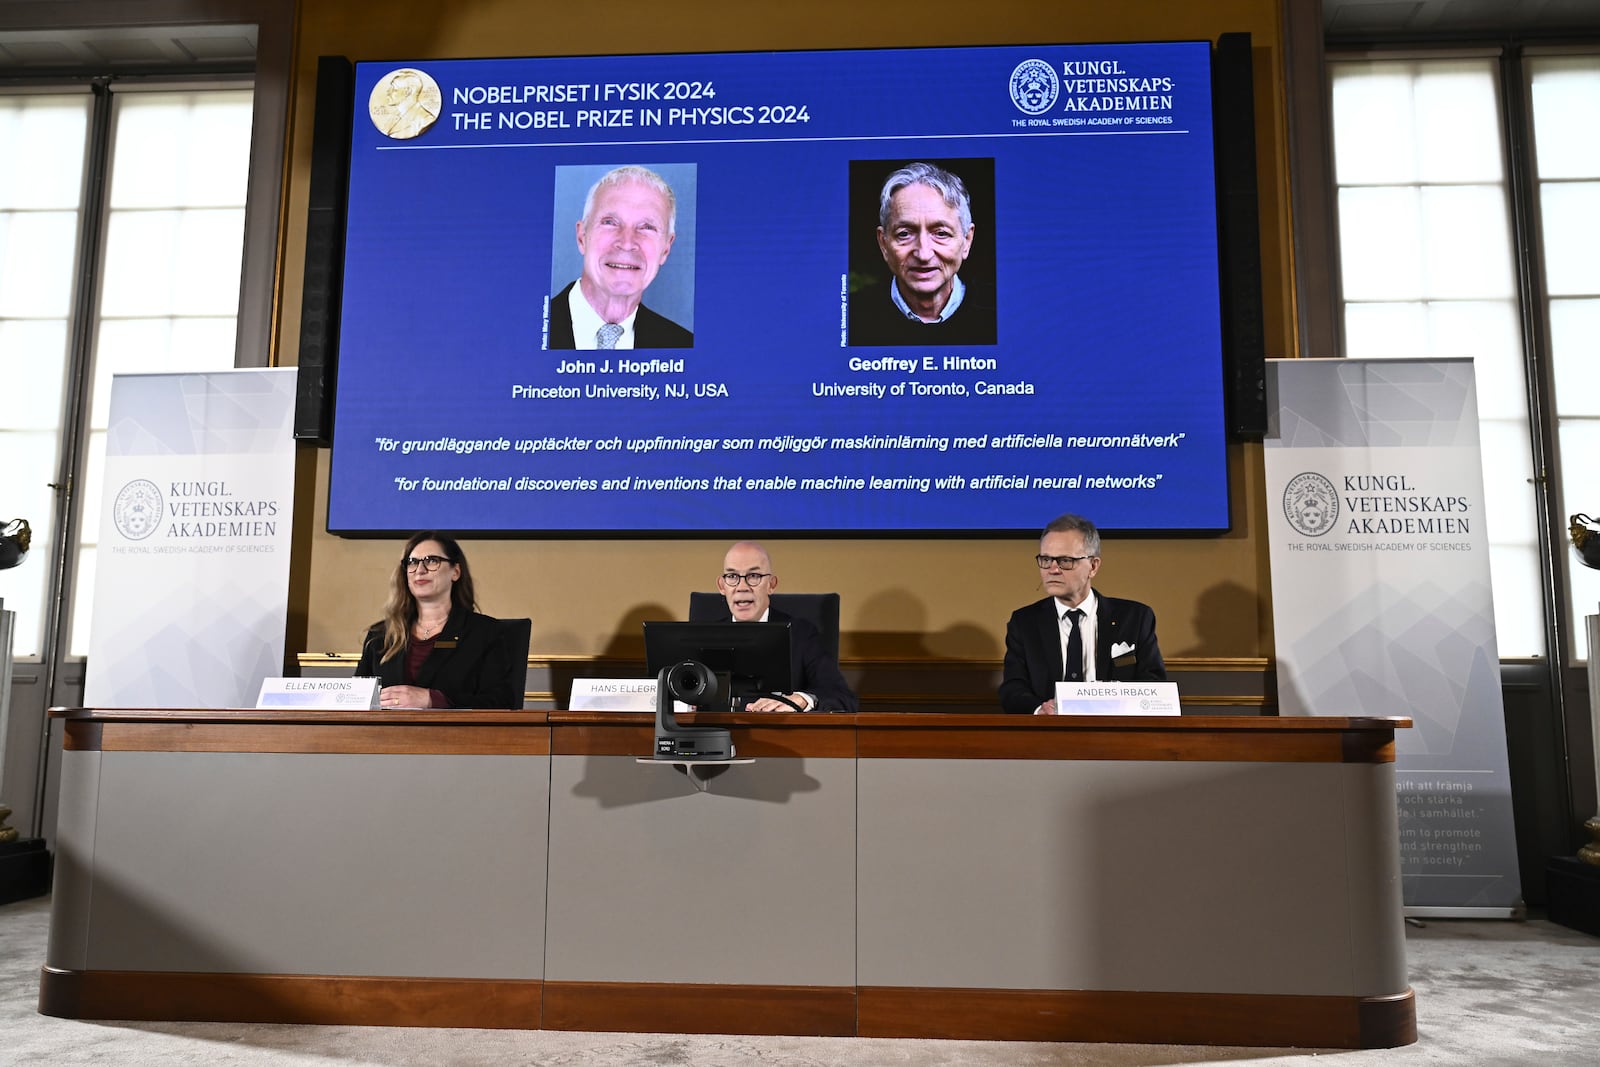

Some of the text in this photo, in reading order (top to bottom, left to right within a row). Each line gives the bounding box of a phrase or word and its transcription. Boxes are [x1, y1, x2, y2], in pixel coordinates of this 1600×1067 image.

[1064, 61, 1125, 75] KUNGL.
[454, 85, 590, 104] NOBELPRISET
[595, 85, 599, 101] I
[605, 83, 660, 100] FYSIK
[664, 82, 715, 99] 2024
[1064, 78, 1175, 93] VETENSKAPS-
[1064, 96, 1172, 111] AKADEMIEN
[452, 106, 810, 130] THE NOBEL PRIZE IN PHYSICS 2024
[557, 359, 683, 376] John J. Hopfield
[849, 357, 996, 373] Geoffrey E. Hinton
[513, 384, 728, 400] Princeton University, NJ, USA
[813, 381, 1034, 398] University of Toronto, Canada
[402, 437, 510, 454] grundläggande
[515, 437, 593, 453] upptäckter
[596, 437, 622, 450] och
[627, 436, 719, 452] uppfinningar
[722, 439, 753, 449] som
[758, 436, 828, 452] möjliggör
[831, 435, 949, 451] maskininlärning
[953, 435, 987, 448] med
[991, 434, 1062, 448] artificiella
[171, 482, 232, 496] KUNGL.
[422, 477, 512, 490] foundational
[515, 477, 597, 490] discoveries
[602, 477, 630, 490] and
[634, 477, 709, 490] inventions
[713, 477, 742, 489] that
[746, 476, 796, 489] enable
[801, 476, 865, 489] machine
[869, 476, 930, 492] learning
[935, 475, 965, 489] with
[970, 475, 1029, 489] artificial
[1033, 475, 1082, 488] neural
[1344, 476, 1414, 491] KUNGL.
[1345, 497, 1471, 512] VETENSKAPS-
[168, 522, 275, 537] AKADEMIEN
[1347, 519, 1469, 534] AKADEMIEN
[128, 546, 149, 554] ROYAL
[153, 546, 186, 554] SWEDISH
[226, 545, 235, 553] OF
[236, 545, 275, 553] SCIENCES
[1335, 543, 1372, 551] SWEDISH
[1375, 543, 1415, 551] ACADEMY
[1418, 543, 1428, 551] OF
[1430, 543, 1471, 551] SCIENCES
[318, 682, 352, 690] MOONS
[1077, 688, 1118, 696] ANDERS
[1417, 781, 1432, 790] att
[1404, 795, 1423, 804] och
[1420, 829, 1431, 837] to
[1435, 829, 1481, 839] promote
[1421, 842, 1481, 853] strengthen
